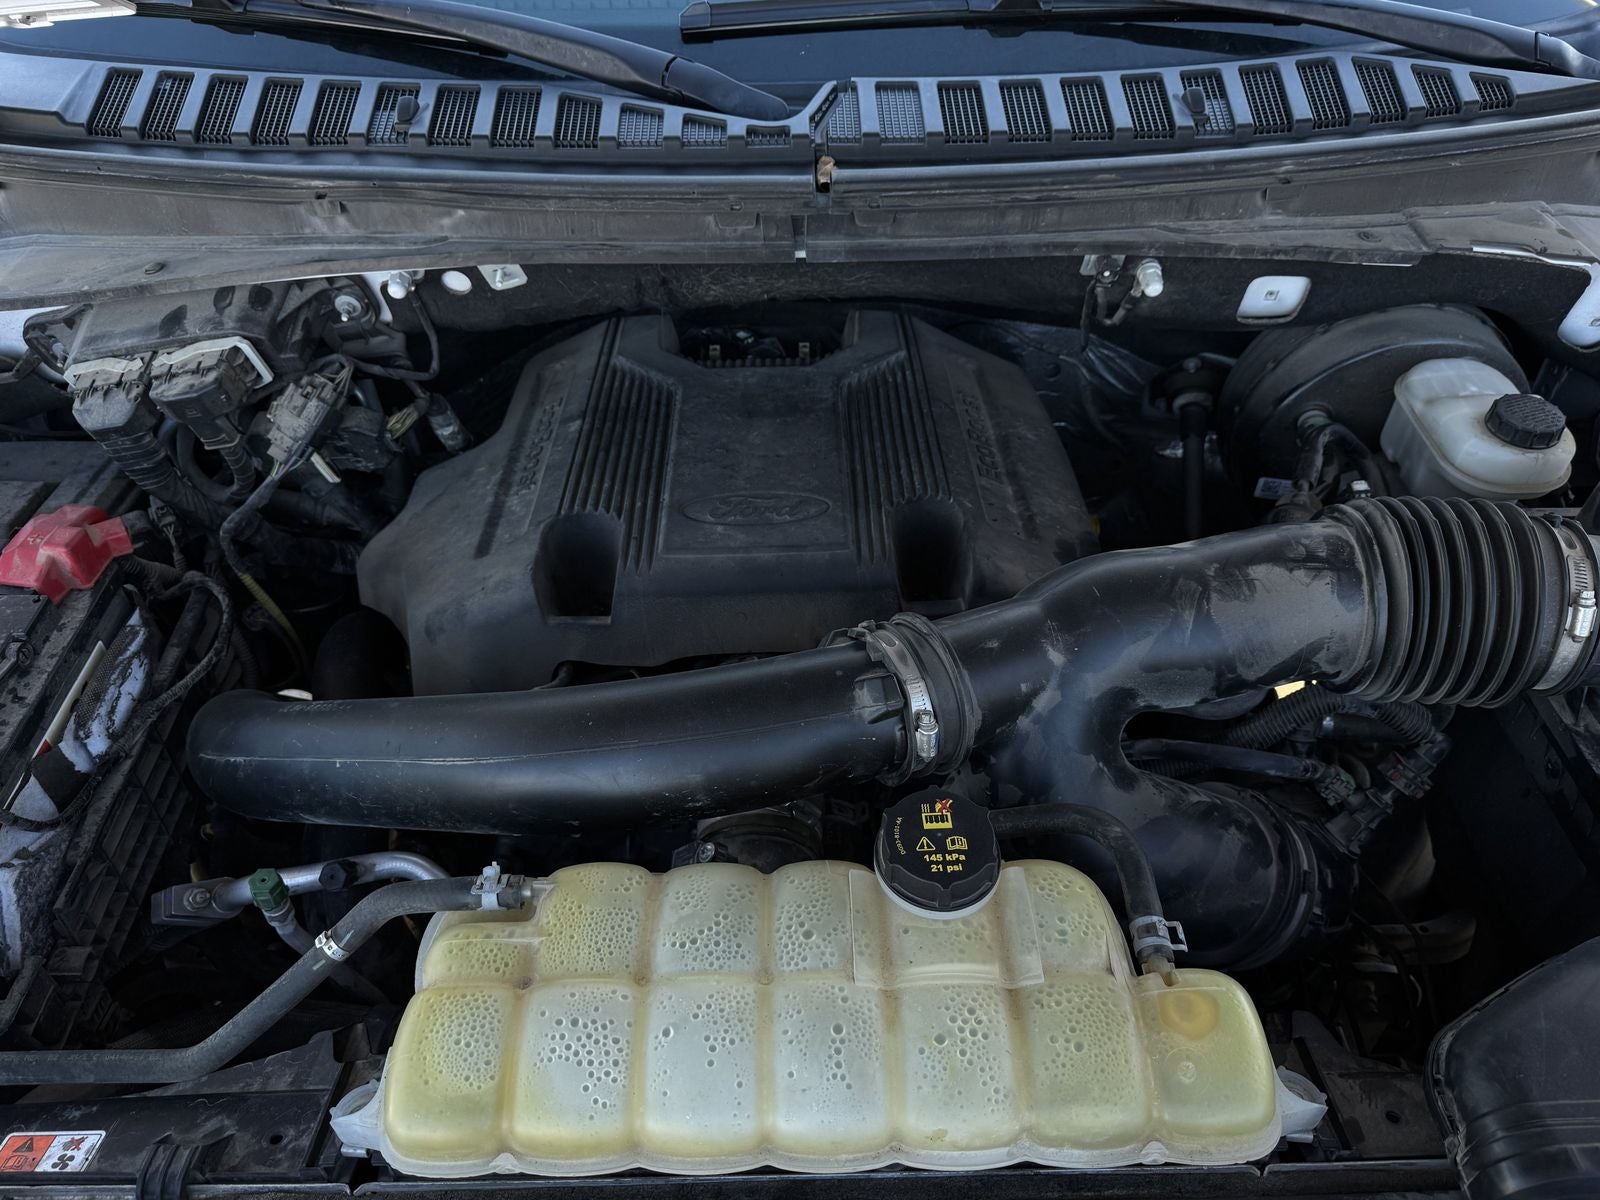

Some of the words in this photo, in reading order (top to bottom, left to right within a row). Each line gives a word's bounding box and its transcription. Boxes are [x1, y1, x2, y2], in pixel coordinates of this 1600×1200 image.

[923, 853, 943, 862] 145
[946, 853, 966, 861] kPa
[930, 864, 943, 872] 21
[947, 863, 963, 873] psi
